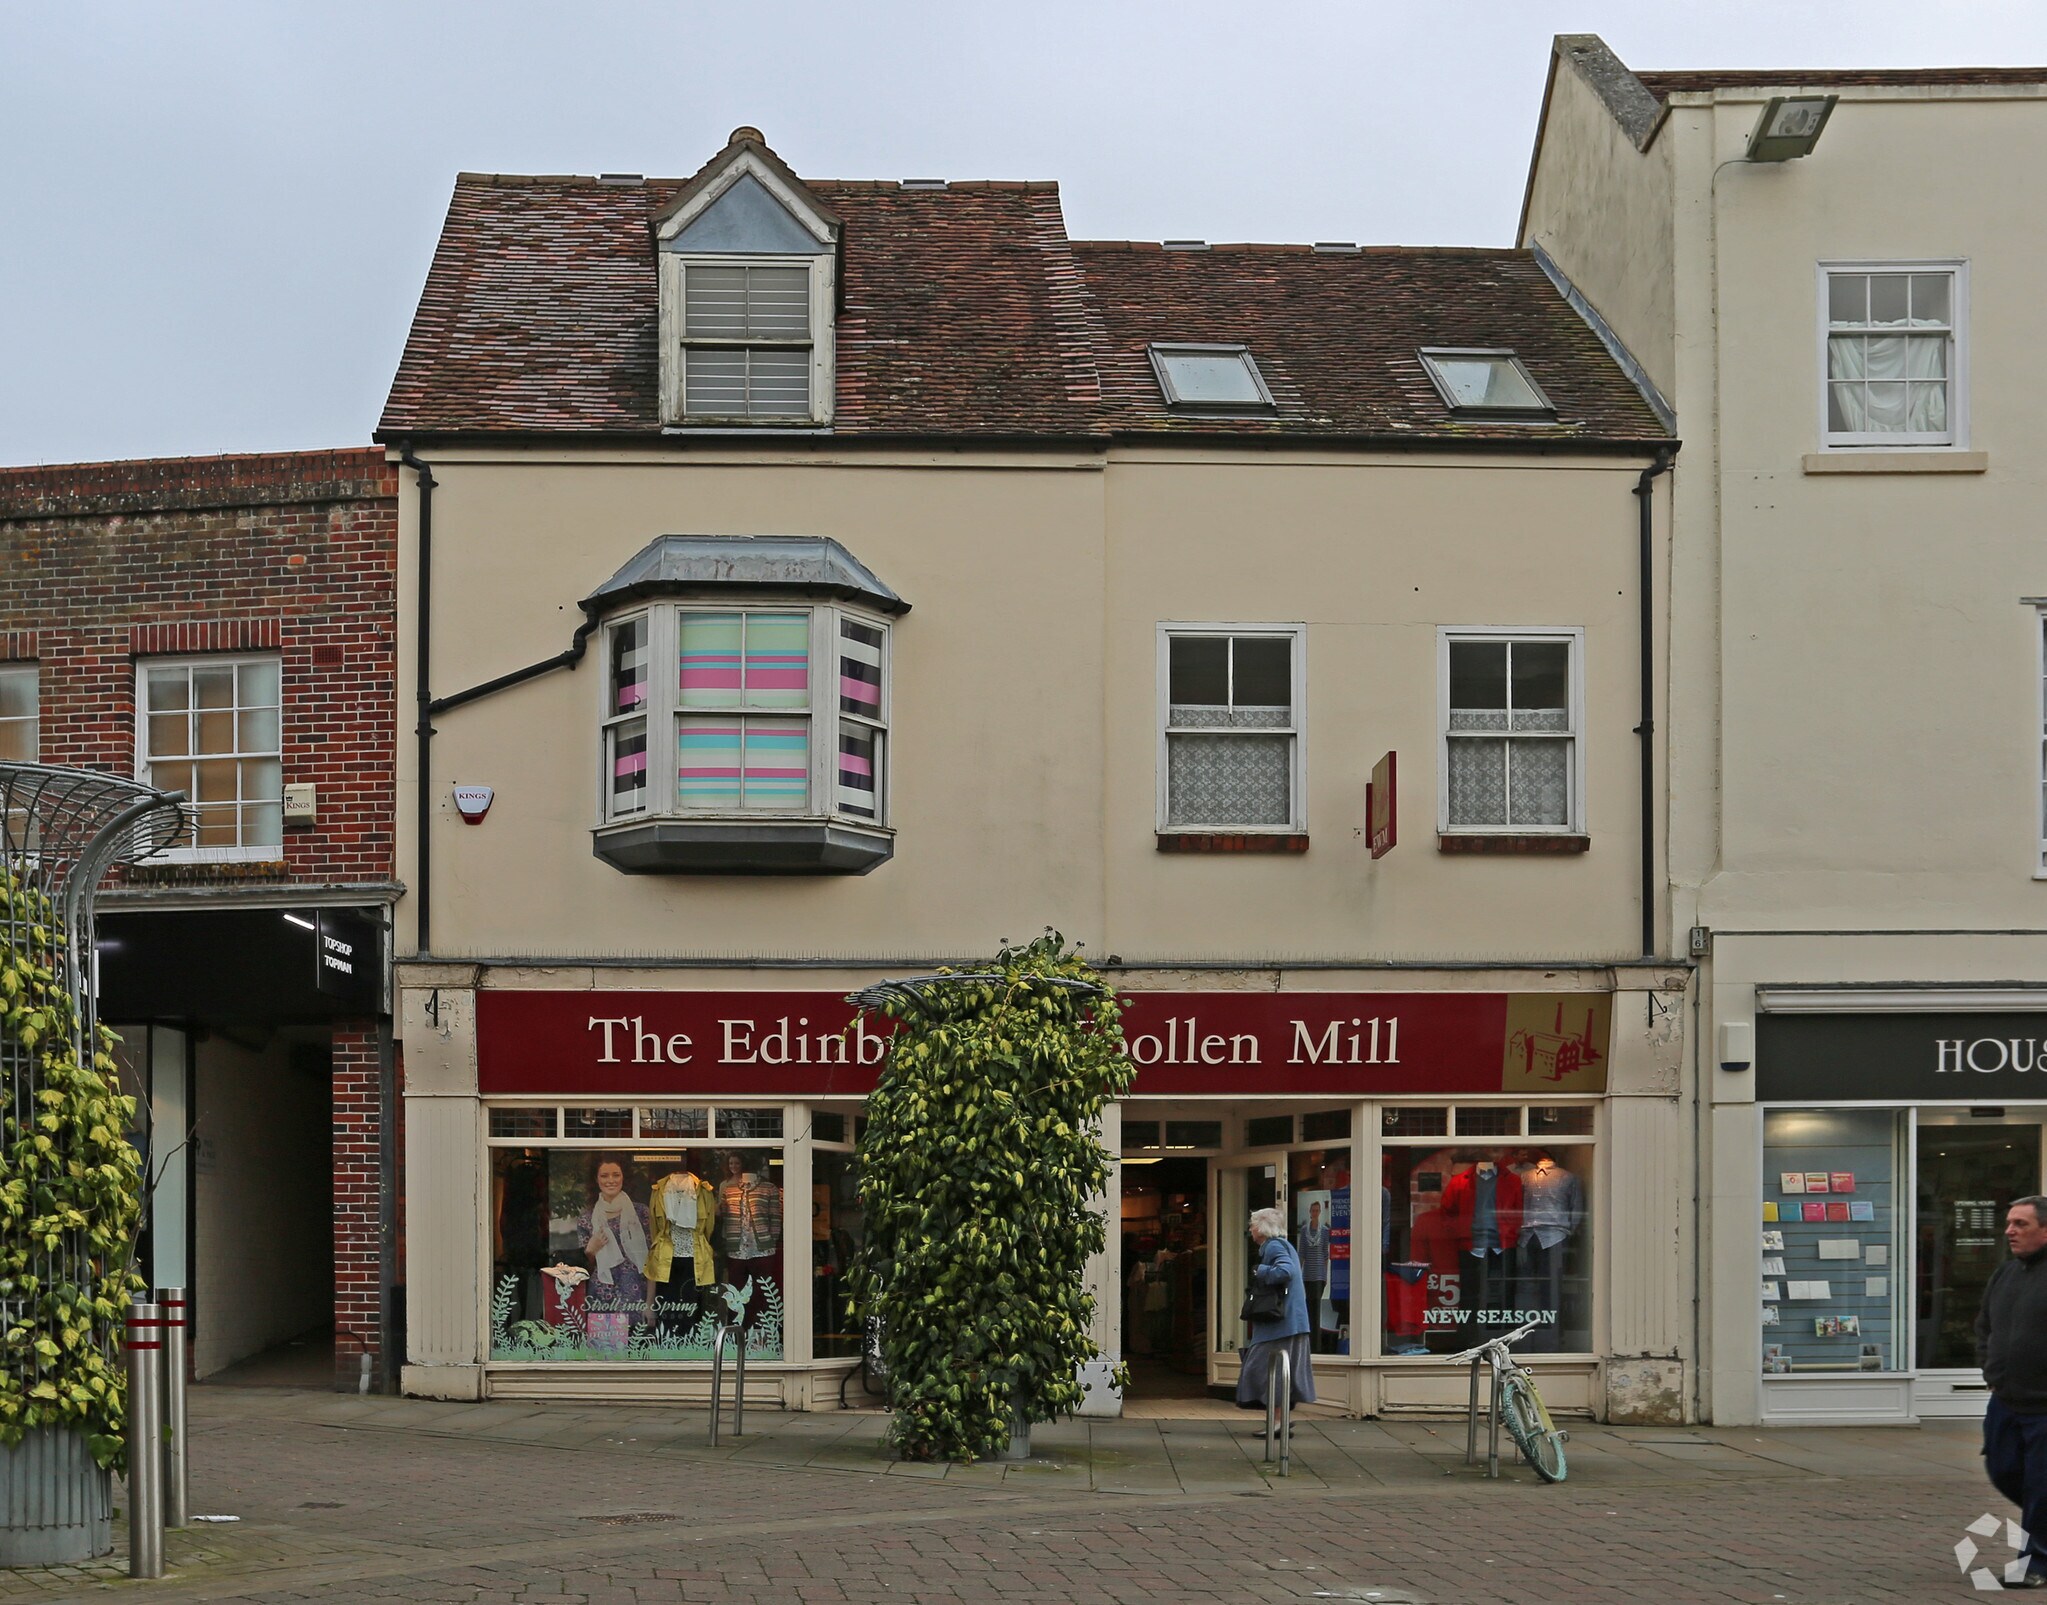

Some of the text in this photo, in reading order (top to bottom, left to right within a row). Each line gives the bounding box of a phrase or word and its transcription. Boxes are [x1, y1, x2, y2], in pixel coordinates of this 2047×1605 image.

[323, 935, 353, 956] TOPSHOP
[324, 954, 352, 974] TOPMAN
[588, 1016, 1400, 1065] The Edinb ollen Mill
[1427, 1273, 1461, 1306] £5
[580, 1295, 698, 1317] Stroll into Spring
[1422, 1310, 1557, 1324] NEW SEASON
